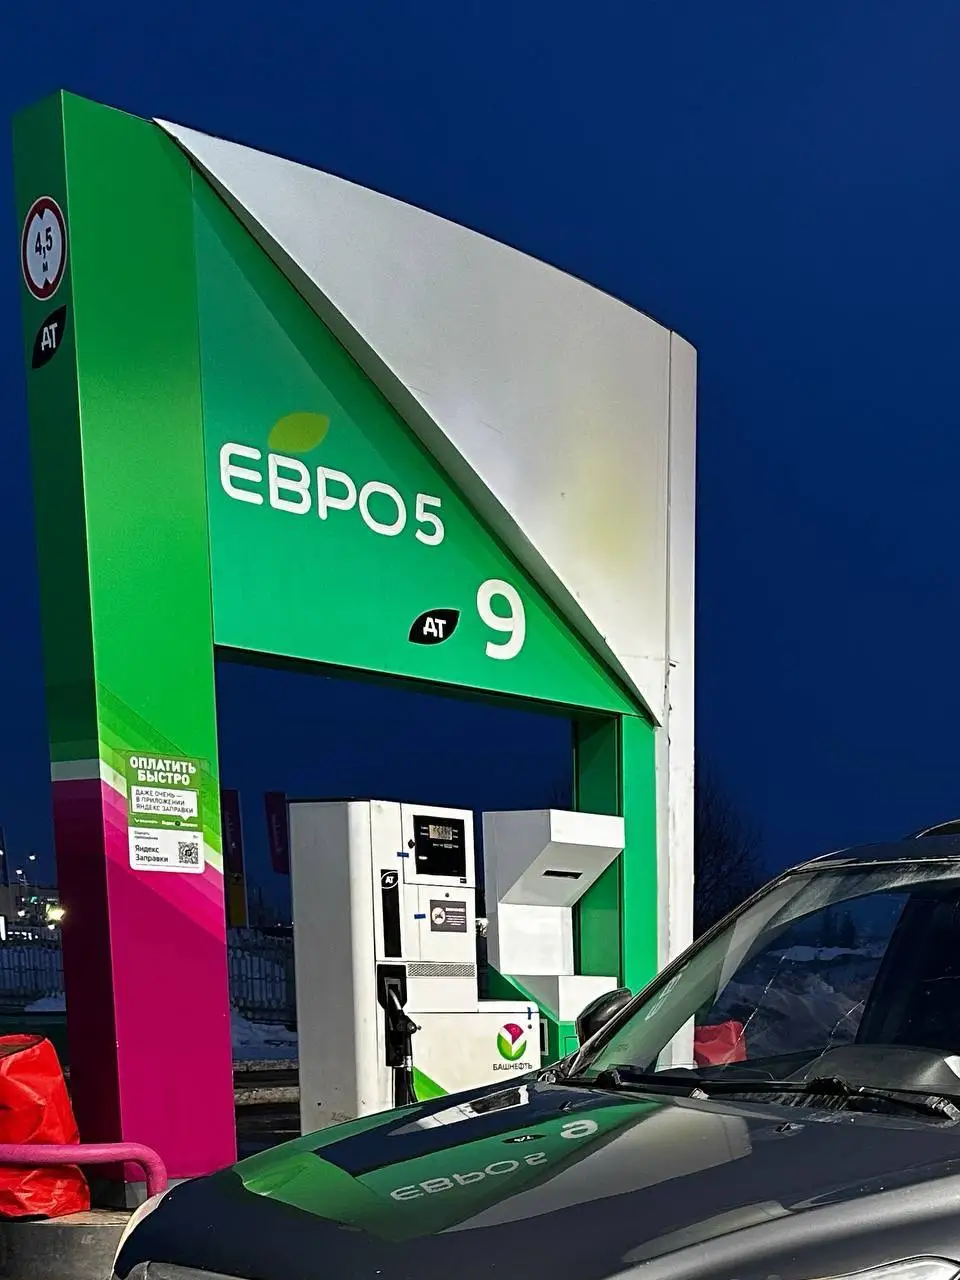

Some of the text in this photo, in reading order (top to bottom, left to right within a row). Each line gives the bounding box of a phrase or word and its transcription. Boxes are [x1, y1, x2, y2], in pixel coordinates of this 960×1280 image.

[35, 226, 53, 259] 4,5
[476, 578, 526, 661] 9
[129, 755, 197, 774] ОПЛАТИТЬ
[137, 769, 190, 786] БЫСТРО
[135, 789, 153, 797] ДАЖЕ
[154, 790, 176, 798] ОЧЕНЬ
[161, 805, 194, 814] ЗАПРАВКИ
[135, 844, 160, 854] Яндекс
[135, 853, 169, 863] Заправки
[492, 1062, 533, 1071] БАШНЕФТЬ
